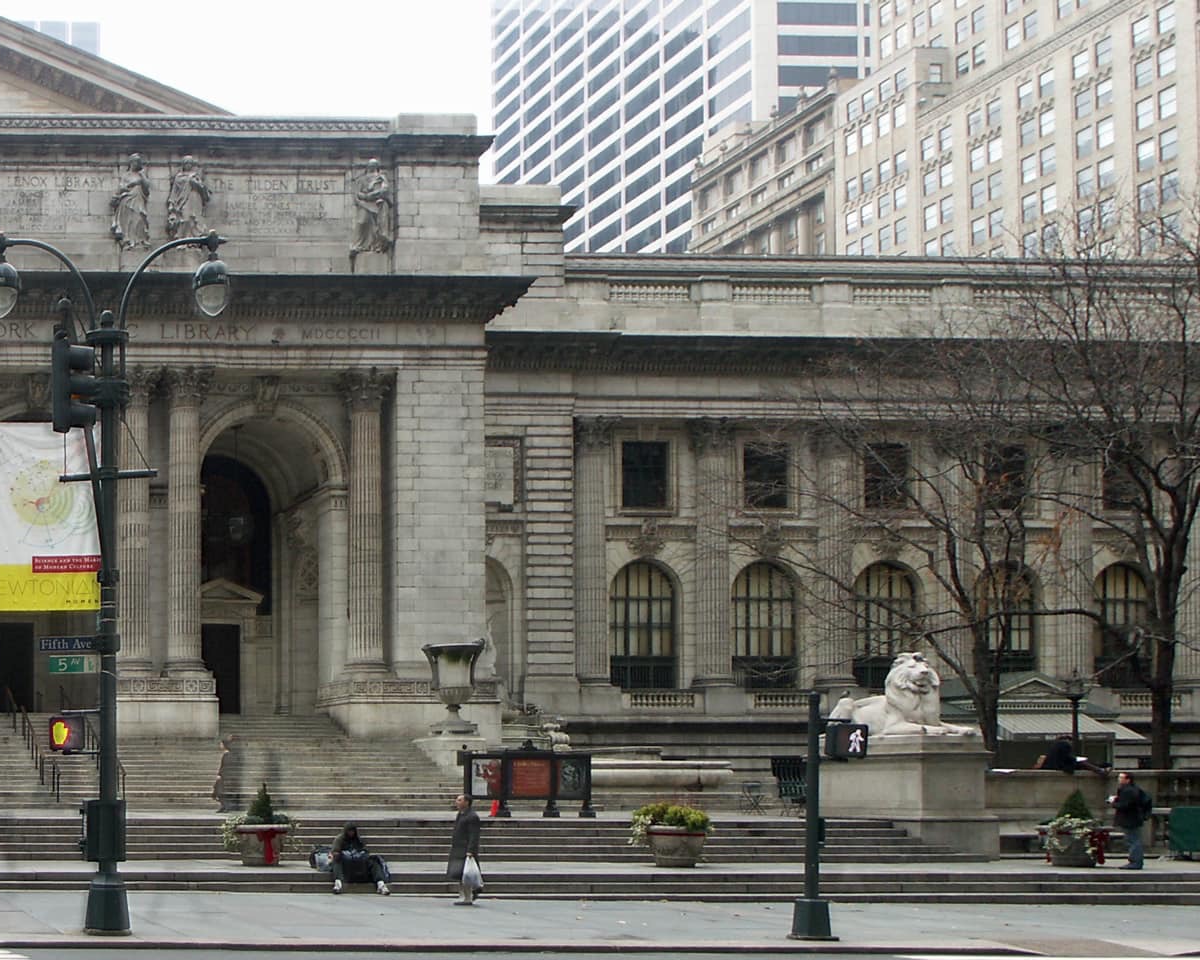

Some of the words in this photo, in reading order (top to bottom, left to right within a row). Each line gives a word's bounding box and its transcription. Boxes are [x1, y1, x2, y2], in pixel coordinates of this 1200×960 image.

[7, 176, 48, 188] LENOX
[54, 176, 105, 188] LIBRARY
[213, 178, 234, 192] THE
[246, 179, 289, 191] TILDEN
[297, 179, 337, 191] TRUST
[160, 322, 257, 342] LIBRARY
[41, 638, 69, 650] Fifth
[72, 638, 92, 649] Ave
[58, 658, 68, 672] 5
[70, 657, 81, 665] AV
